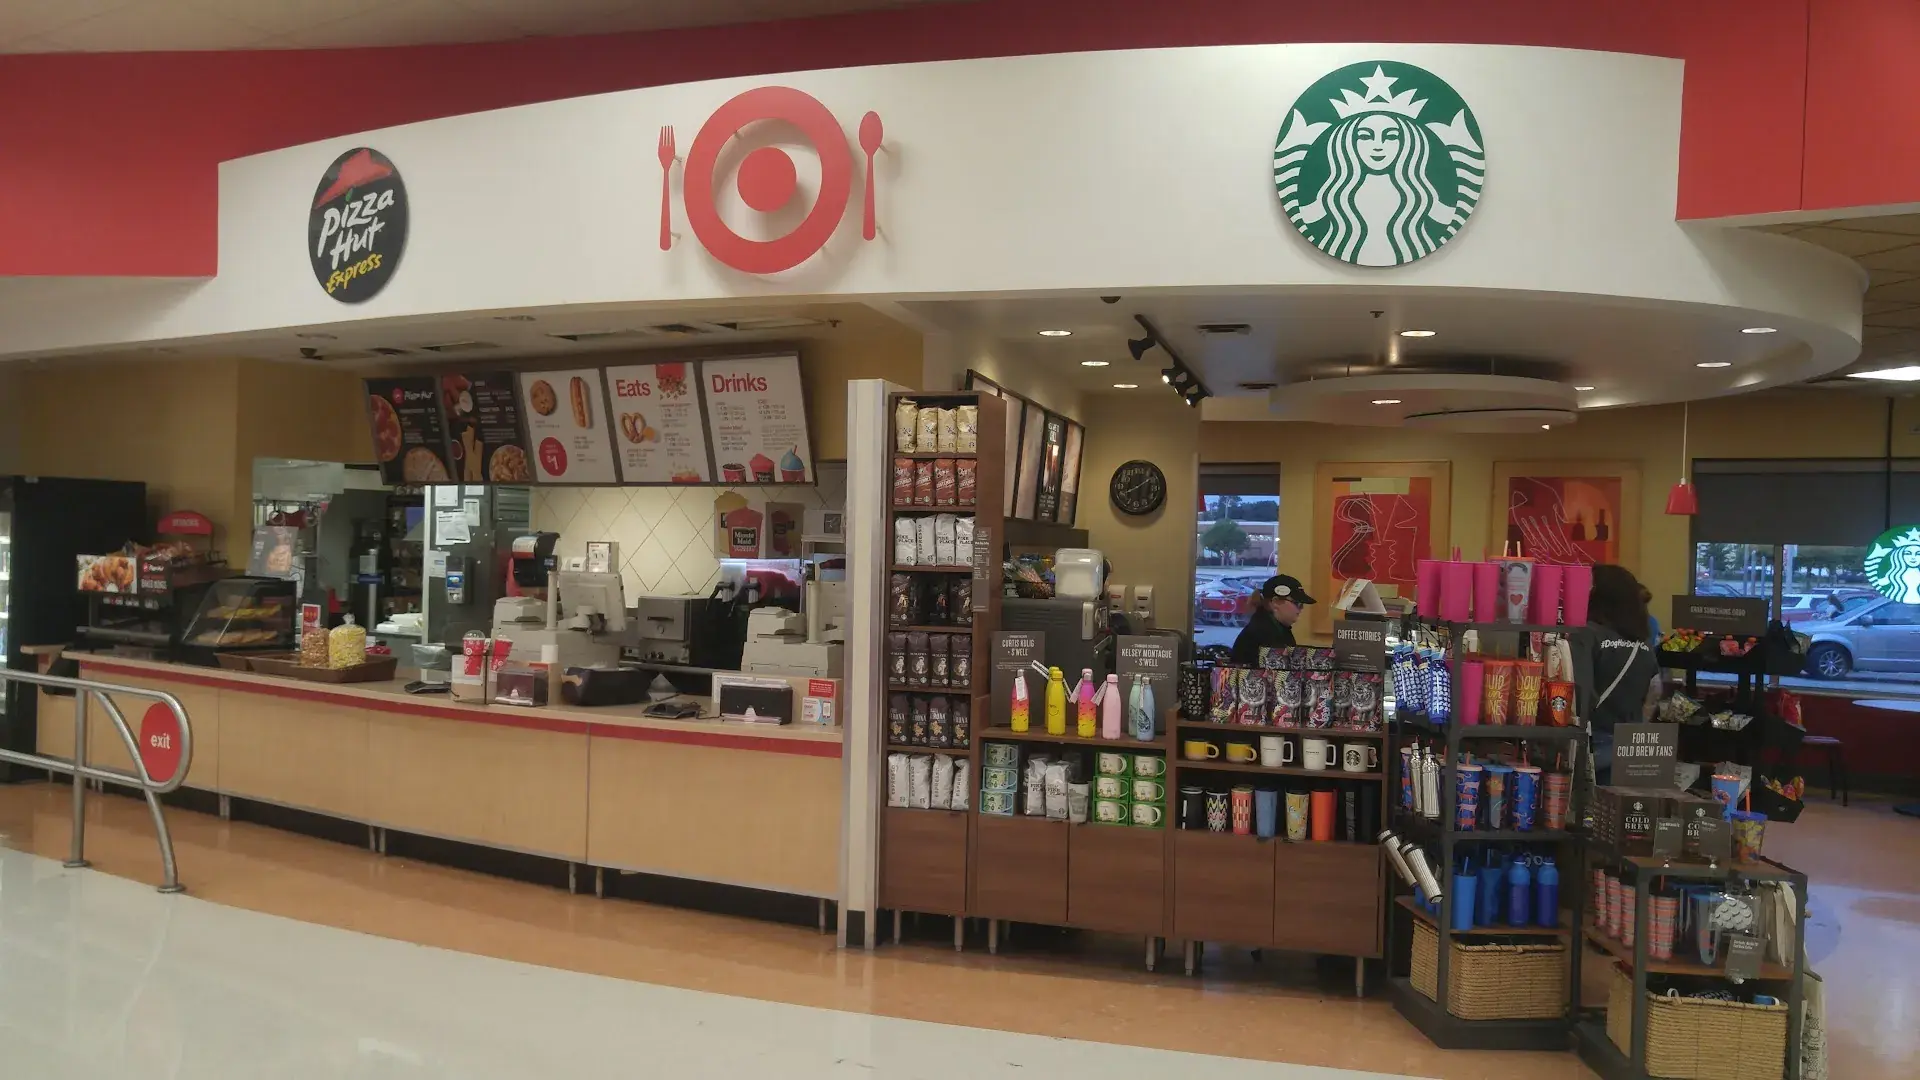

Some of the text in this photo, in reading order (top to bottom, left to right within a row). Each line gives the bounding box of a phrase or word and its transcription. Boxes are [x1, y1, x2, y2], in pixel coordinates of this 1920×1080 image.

[317, 189, 395, 258] Pizza
[330, 217, 385, 270] Hut
[326, 253, 382, 293] Express
[711, 372, 768, 393] Drinks
[616, 379, 651, 398] Eats
[734, 531, 755, 539] Minute
[737, 537, 752, 545] Maid
[1337, 629, 1381, 641] COFFEE STORIES
[1001, 639, 1035, 648] CURTIS KULIG
[1121, 648, 1173, 659] KELSEY MONTAGUE
[1138, 657, 1158, 667] S'WELL
[150, 733, 171, 749] exit
[1632, 732, 1660, 743] FOR THE
[1617, 745, 1673, 757] COLD BREW FANS
[1625, 816, 1650, 824] COLD
[1624, 823, 1650, 831] BREW
[1687, 822, 1700, 830] CO
[1687, 829, 1700, 837] BR
